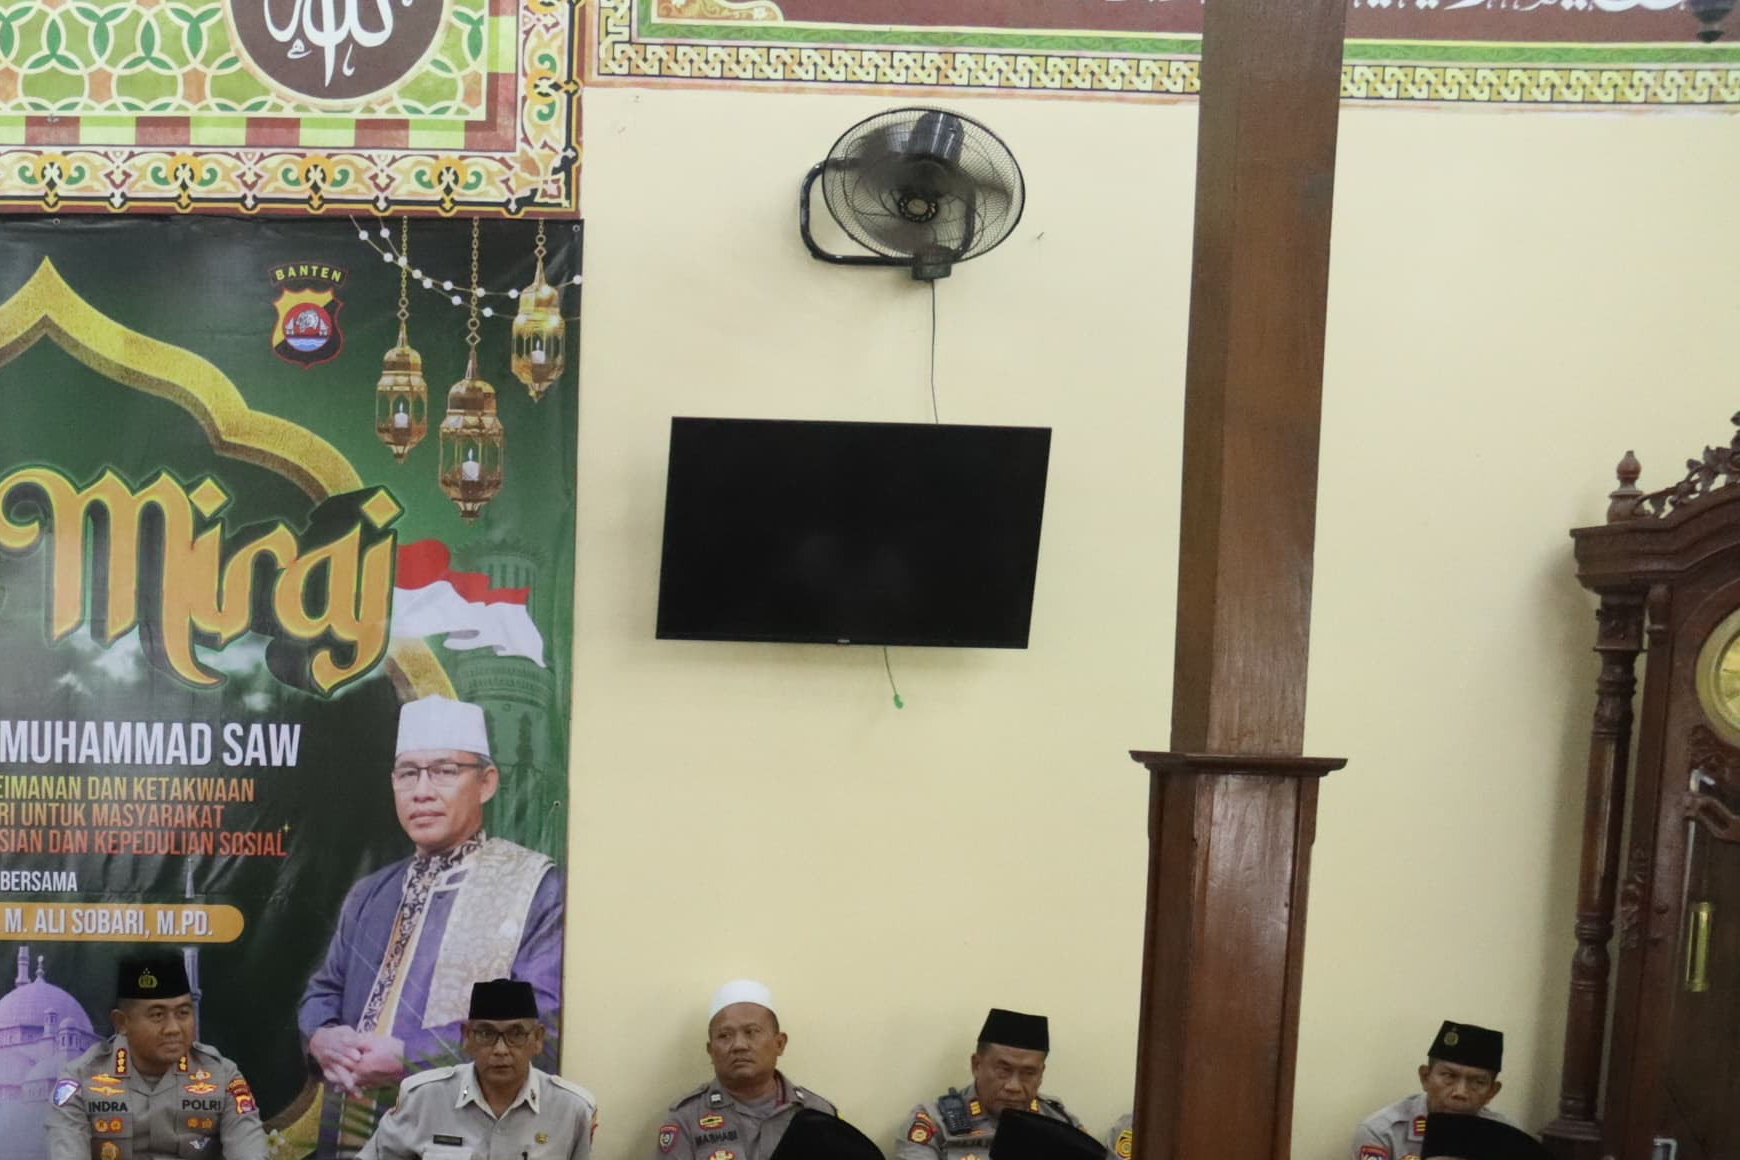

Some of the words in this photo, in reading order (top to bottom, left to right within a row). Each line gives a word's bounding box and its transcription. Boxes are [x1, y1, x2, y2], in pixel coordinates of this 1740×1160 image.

[275, 264, 342, 282] BANTEN
[0, 720, 212, 766] MUHAMMAD
[222, 723, 301, 767] SAW
[87, 776, 127, 801] DAN
[133, 777, 255, 802] KETAKWAAN
[21, 802, 86, 827] UNTUK
[92, 804, 225, 829] MASYARAKAT
[48, 829, 89, 854] DAN
[94, 830, 214, 856] KEPEDULIAN
[219, 831, 288, 857] SOSIAL
[0, 870, 78, 892] BERSAMA
[5, 909, 28, 934] M.
[34, 909, 65, 934] ALI
[71, 910, 150, 938] SOBARI,
[157, 911, 214, 936] M.PD.
[88, 1101, 128, 1113] INDRA
[182, 1099, 221, 1112] POLRI
